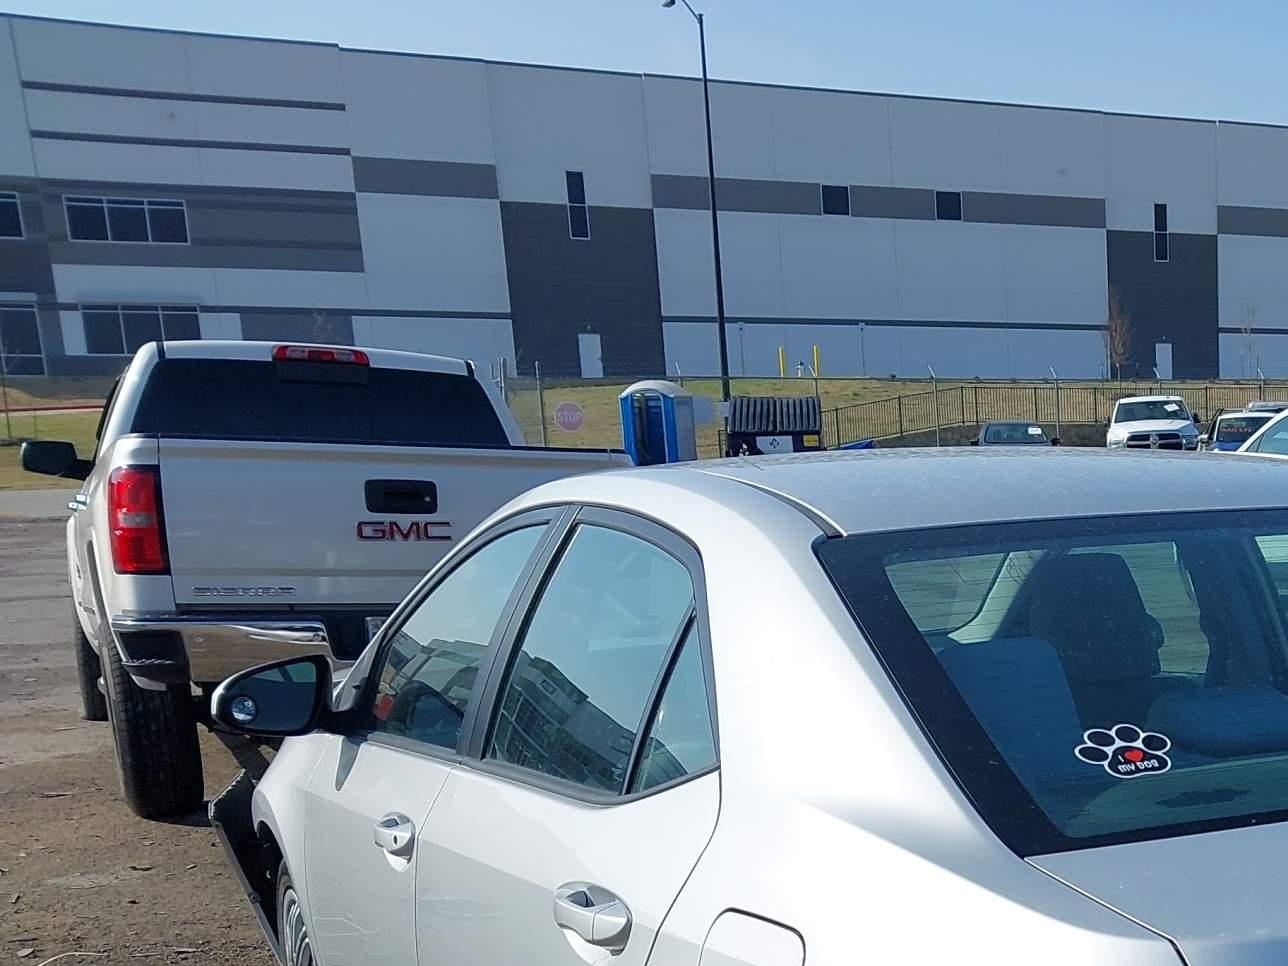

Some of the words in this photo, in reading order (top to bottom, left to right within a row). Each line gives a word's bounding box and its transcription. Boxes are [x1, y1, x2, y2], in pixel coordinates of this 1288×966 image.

[556, 411, 581, 424] STOP
[356, 521, 452, 541] GMC
[192, 586, 296, 597] SIERRA
[1118, 755, 1125, 763] I
[1136, 759, 1160, 769] DOG
